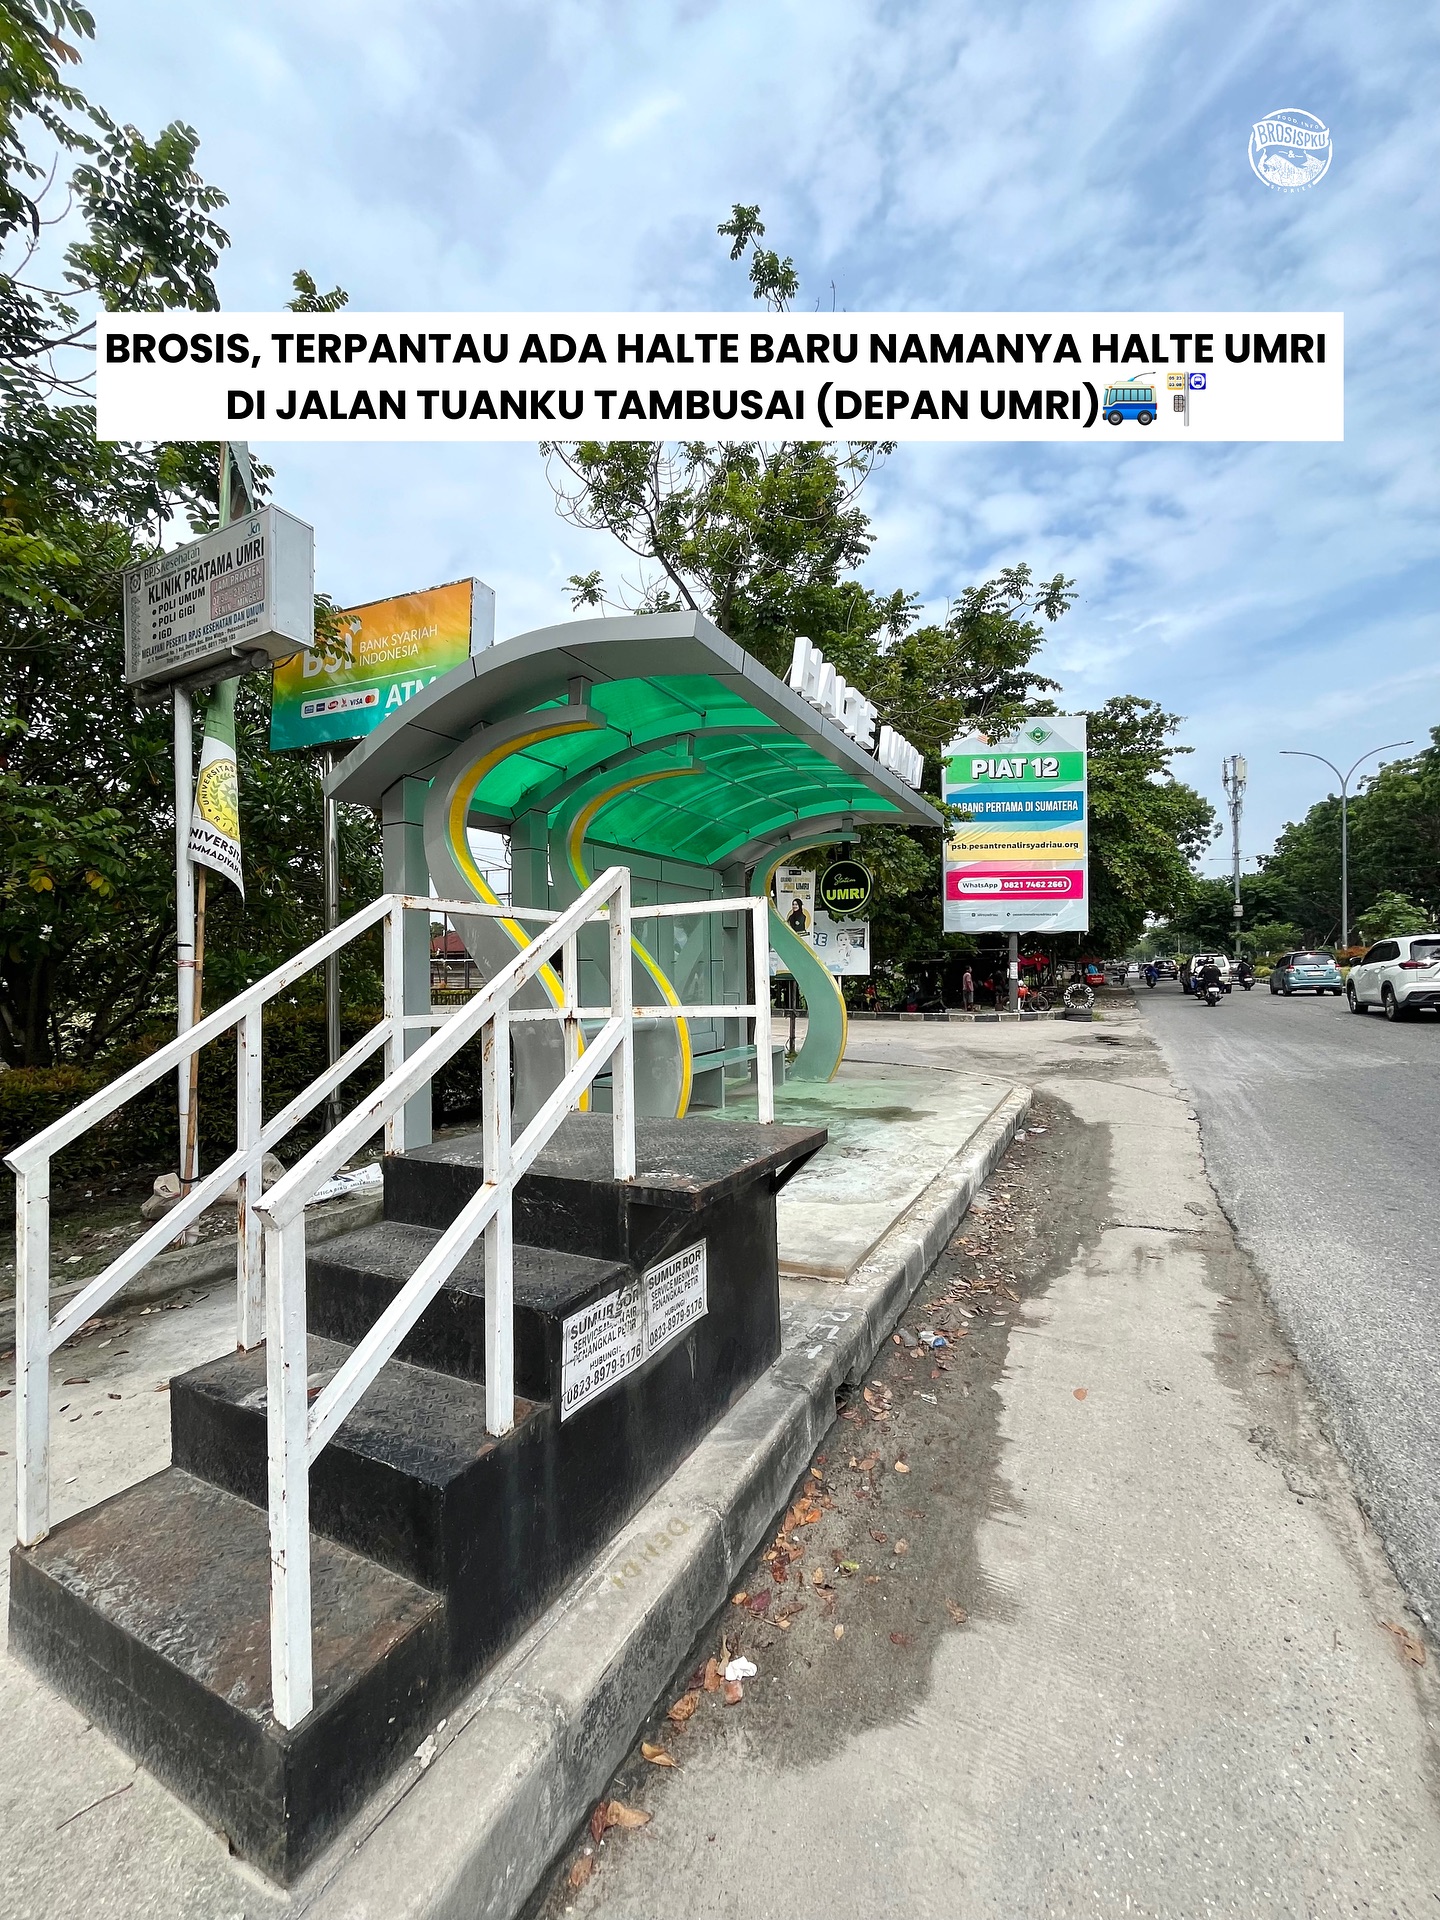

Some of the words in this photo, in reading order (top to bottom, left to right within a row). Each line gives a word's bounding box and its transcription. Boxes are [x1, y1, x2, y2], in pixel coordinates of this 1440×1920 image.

[145, 563, 160, 580] BPJS
[161, 547, 200, 572] Kesehatan
[149, 574, 181, 605] KLINIK
[185, 552, 233, 589] PRATAMA
[236, 536, 264, 567] UMRI
[214, 578, 229, 593] JAM
[230, 565, 261, 585] PRAKTEK
[159, 599, 176, 614] POLI
[179, 586, 205, 605] UMUM
[214, 602, 232, 617] SENIN
[237, 590, 261, 606] MINGGU
[159, 612, 176, 627] POLI
[179, 604, 195, 619] GIGI
[166, 633, 187, 650] PESERTA
[188, 628, 201, 641] BPJS
[203, 615, 233, 635] KESEHATAN
[234, 610, 244, 624] DAN
[246, 602, 264, 618] UMUM
[159, 628, 172, 640] IGD
[360, 636, 389, 654] BANK
[391, 624, 438, 646] SYARIAH
[360, 643, 419, 666] INDONESIA
[350, 698, 363, 706] VISA
[790, 637, 878, 749] HALTE
[879, 725, 925, 789] UMRI
[972, 758, 1028, 779] PIAT
[1030, 757, 1059, 778] 12
[202, 765, 235, 806] UNIVERSITAS
[986, 801, 1023, 812] PERTAMA
[1025, 802, 1034, 811] DI
[1035, 800, 1079, 811] SUMATERA
[951, 841, 1079, 851] psb.pesantrenalirsyadriau.org
[826, 888, 865, 901] UMRI
[962, 882, 998, 890] WhatsApp
[649, 1262, 681, 1290] SUMUR
[683, 1250, 701, 1269] BOR
[651, 1282, 674, 1302] SERVICE
[674, 1271, 690, 1288] MESIN
[690, 1264, 700, 1278] AIR
[652, 1286, 684, 1313] PENANGKAL
[684, 1275, 699, 1292] PETIR
[570, 1303, 614, 1340] SUMUR
[616, 1289, 639, 1313] BOR
[650, 1297, 702, 1346] 0823-8979-5176
[567, 1343, 642, 1404] 0823-8979-5176
